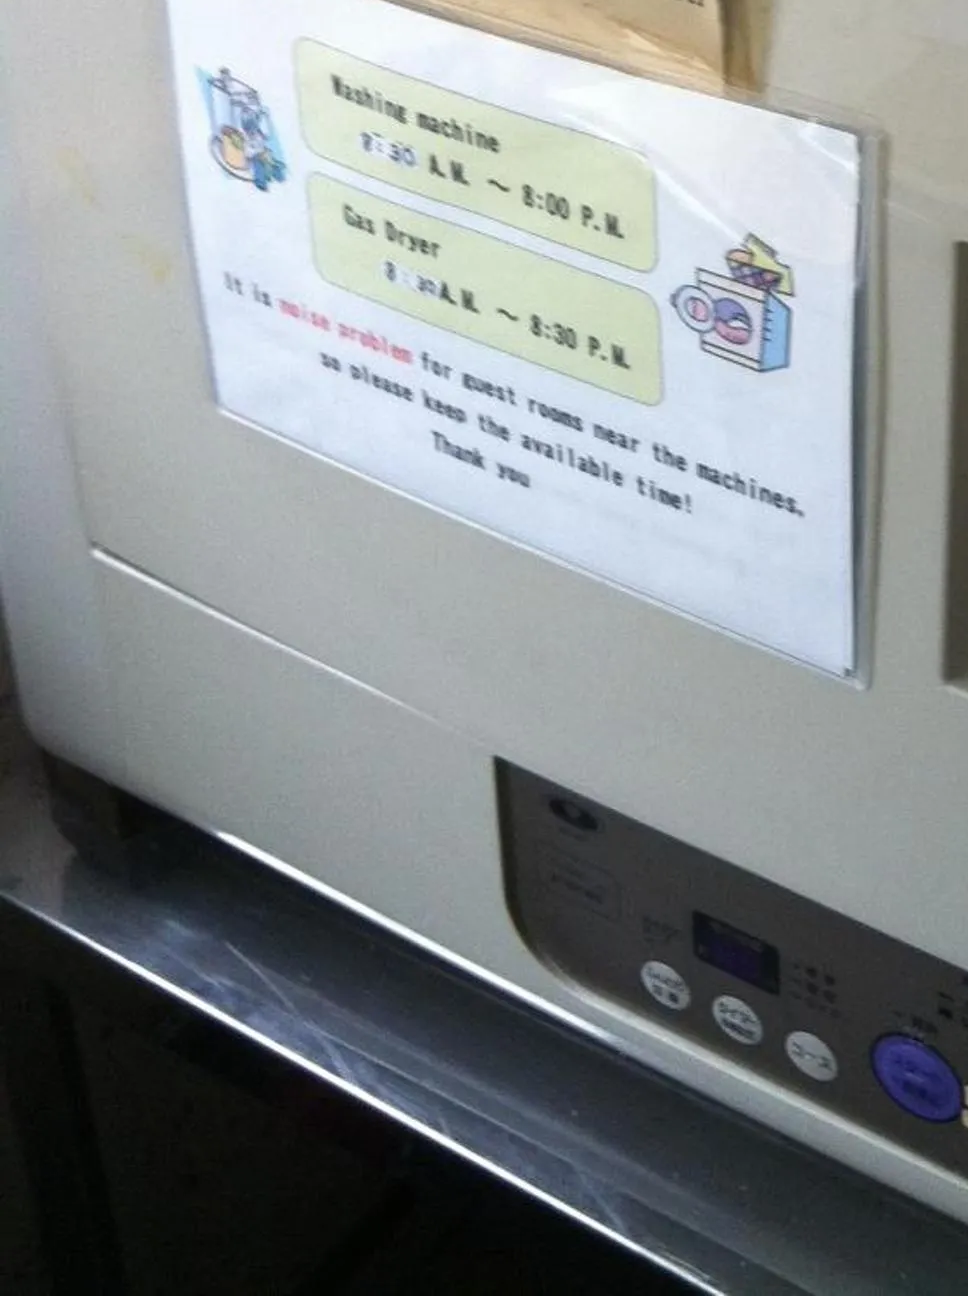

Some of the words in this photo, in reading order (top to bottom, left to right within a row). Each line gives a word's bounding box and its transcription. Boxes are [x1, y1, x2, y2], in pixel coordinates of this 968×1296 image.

[330, 73, 409, 125] Washing
[416, 111, 501, 153] machine
[342, 204, 377, 236] Gas
[383, 220, 442, 259] Dryer
[521, 184, 570, 221] 8:00
[579, 204, 626, 239] P.M.
[223, 271, 243, 296] It
[252, 283, 273, 308] is
[420, 351, 453, 380] for
[461, 372, 517, 406] guest
[526, 398, 584, 432] rooms
[592, 421, 641, 453] near
[651, 442, 689, 472] the
[530, 314, 578, 350] 8:30
[587, 335, 632, 370] P.M.
[319, 351, 343, 373] so
[348, 362, 414, 403] please
[422, 389, 468, 424] keep
[477, 413, 511, 442] the
[519, 433, 624, 487] available
[636, 475, 693, 516] time!
[430, 430, 487, 471] Thank
[495, 462, 532, 490] you
